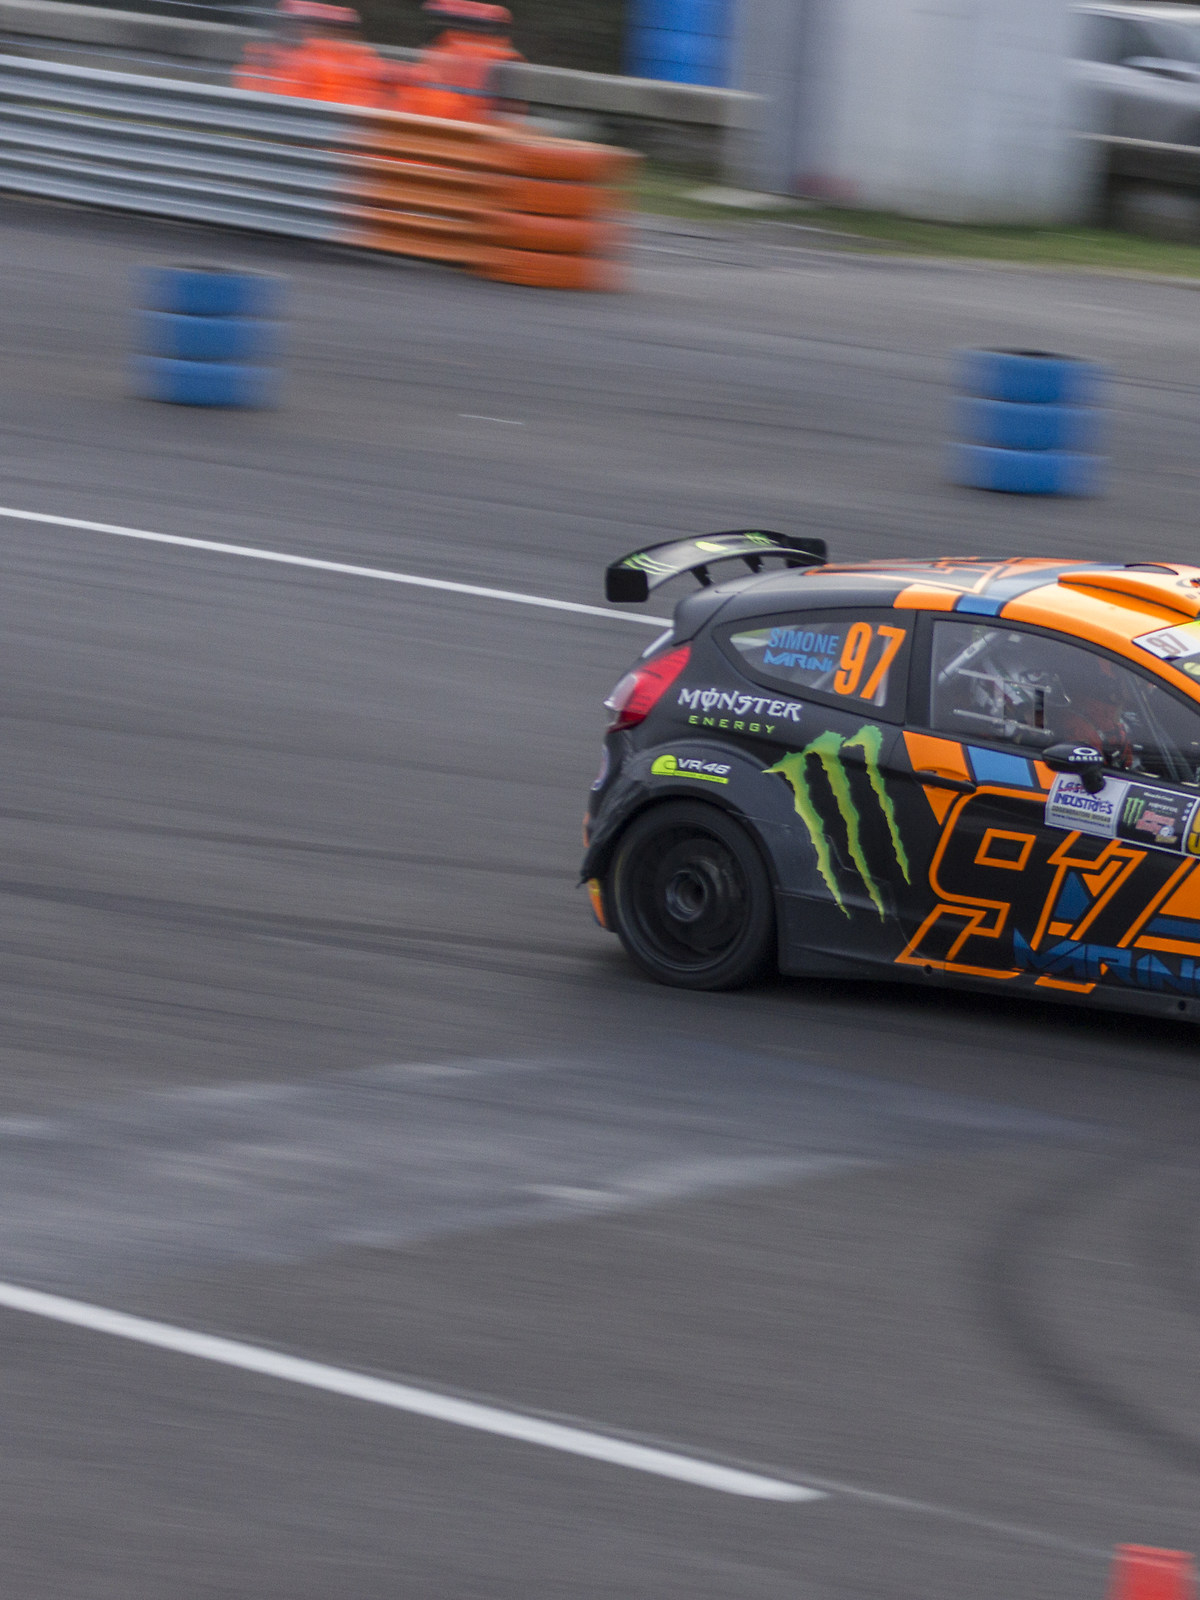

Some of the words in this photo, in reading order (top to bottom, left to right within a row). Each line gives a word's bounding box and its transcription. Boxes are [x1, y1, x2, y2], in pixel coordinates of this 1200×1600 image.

[767, 627, 840, 655] SIMONE
[833, 622, 906, 699] 97
[677, 687, 802, 722] MONSTER
[688, 715, 775, 734] ENERGY
[1053, 793, 1115, 815] INDUSTRIES
